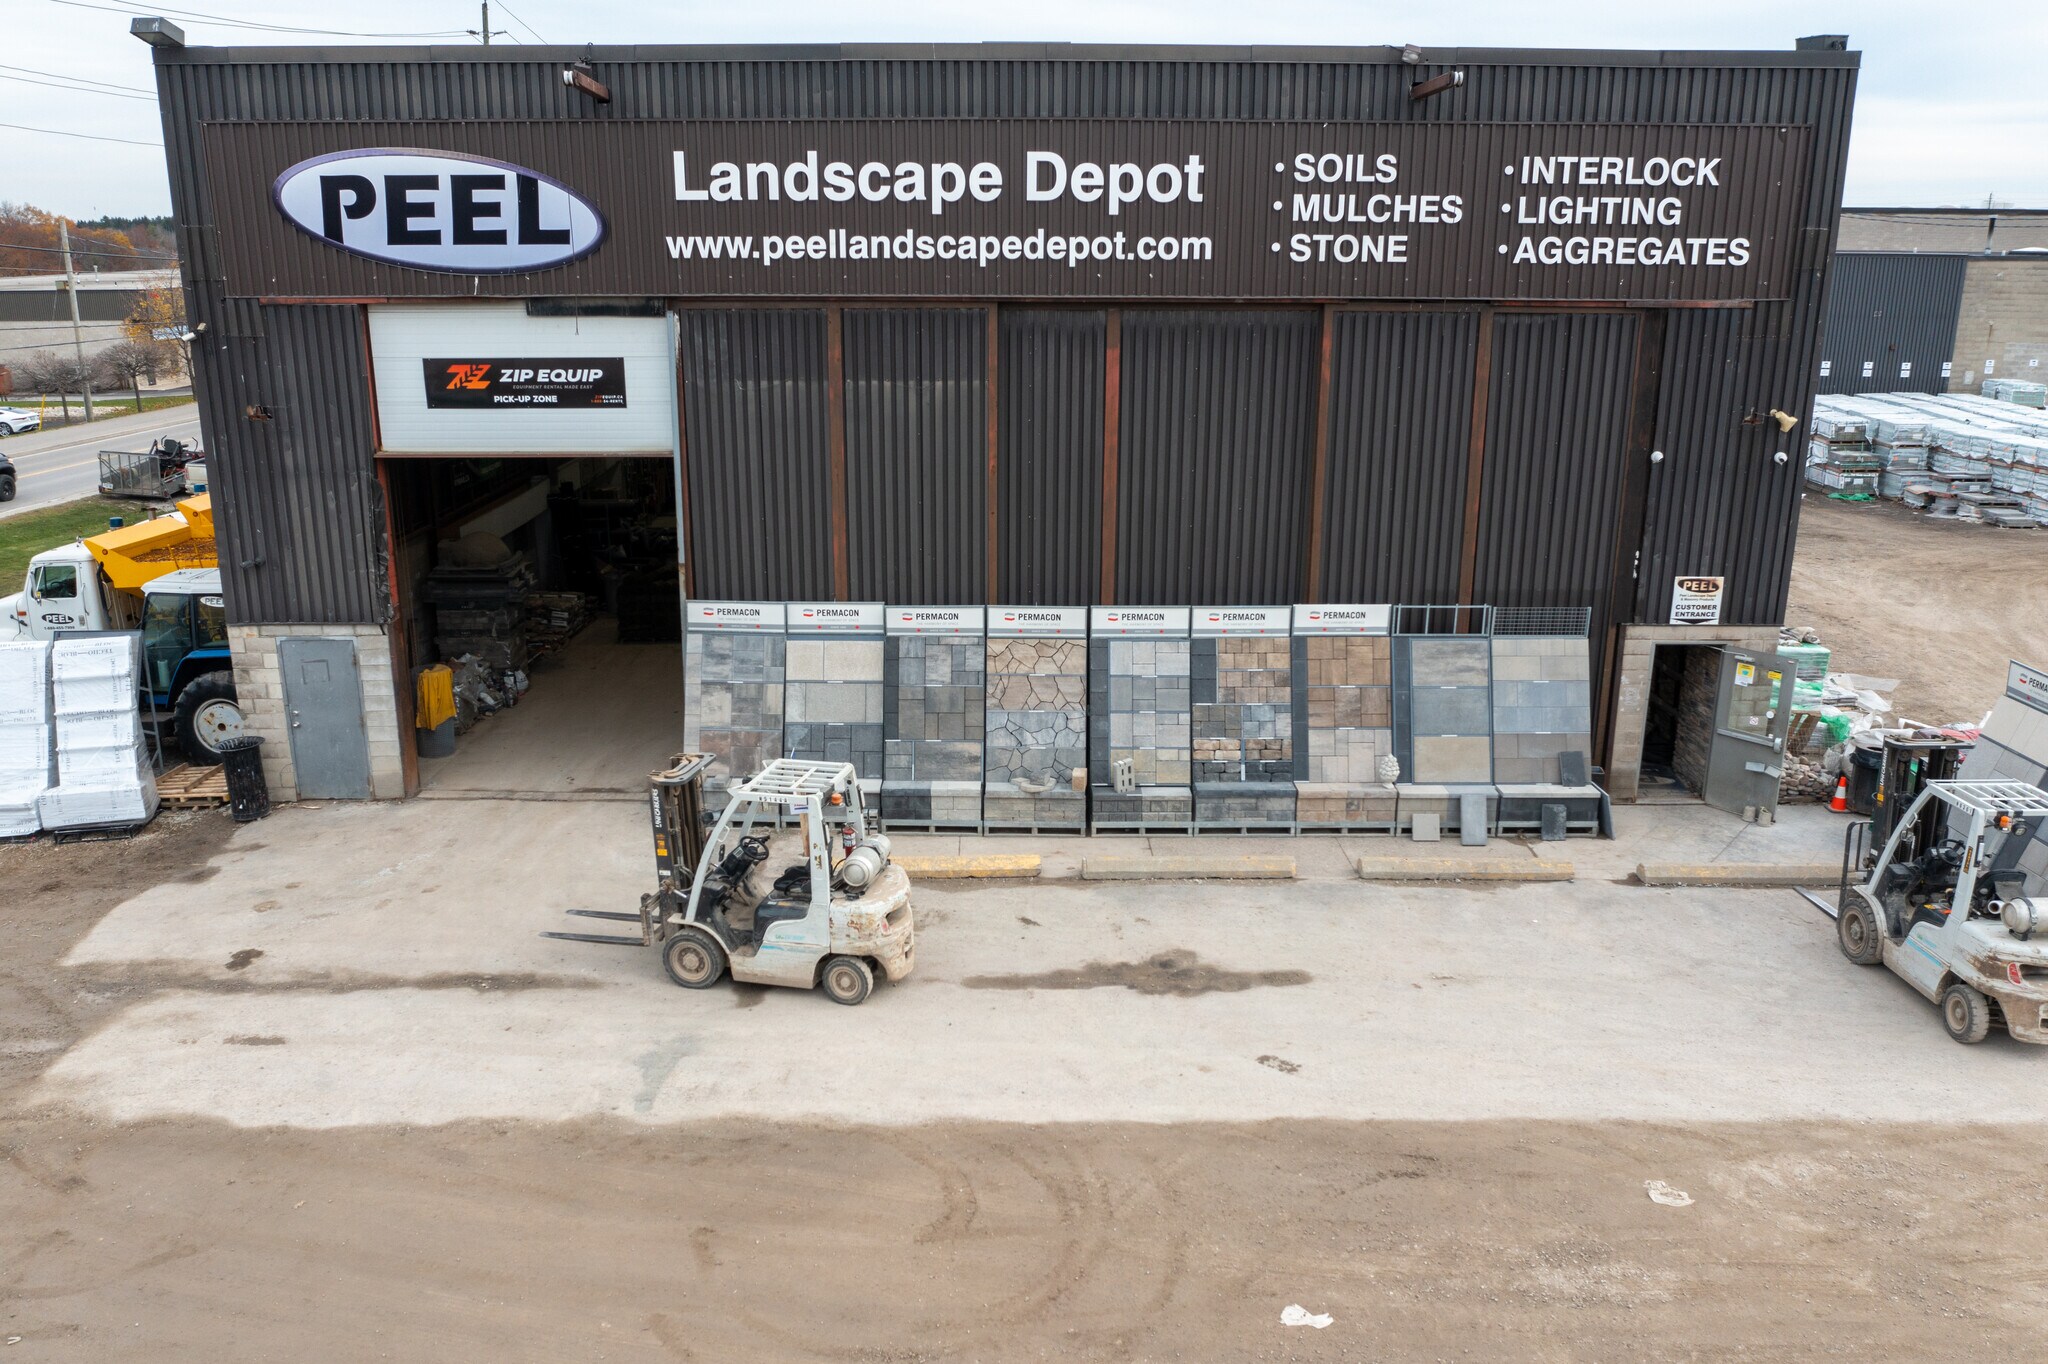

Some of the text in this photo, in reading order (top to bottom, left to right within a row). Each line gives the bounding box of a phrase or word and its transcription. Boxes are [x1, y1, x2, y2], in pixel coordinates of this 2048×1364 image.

[1293, 153, 1398, 183] SOILS
[1520, 156, 1721, 186] INTERLOCK
[673, 150, 1205, 215] Landscape Depot
[319, 173, 571, 245] PEEL
[1292, 193, 1463, 224] MULCHES
[1517, 195, 1682, 226] LIGHTING
[665, 228, 1213, 268] www.peellandscapedepot.com
[1289, 233, 1408, 263] STONE
[1512, 236, 1750, 266] AGGREGATES
[499, 368, 604, 383] ZIP EQUIP
[494, 395, 558, 403] PICK-UP ZONE
[1683, 581, 1716, 590] PEEL
[45, 613, 72, 623] PEEL
[717, 608, 761, 617] PERMACON
[816, 609, 860, 617] PERMACON
[915, 612, 959, 620] PERMACON
[1018, 613, 1062, 621] PERMACON
[1121, 613, 1165, 621] PERMACON
[1222, 613, 1266, 621] PERMACON
[1323, 611, 1366, 619] PERMACON
